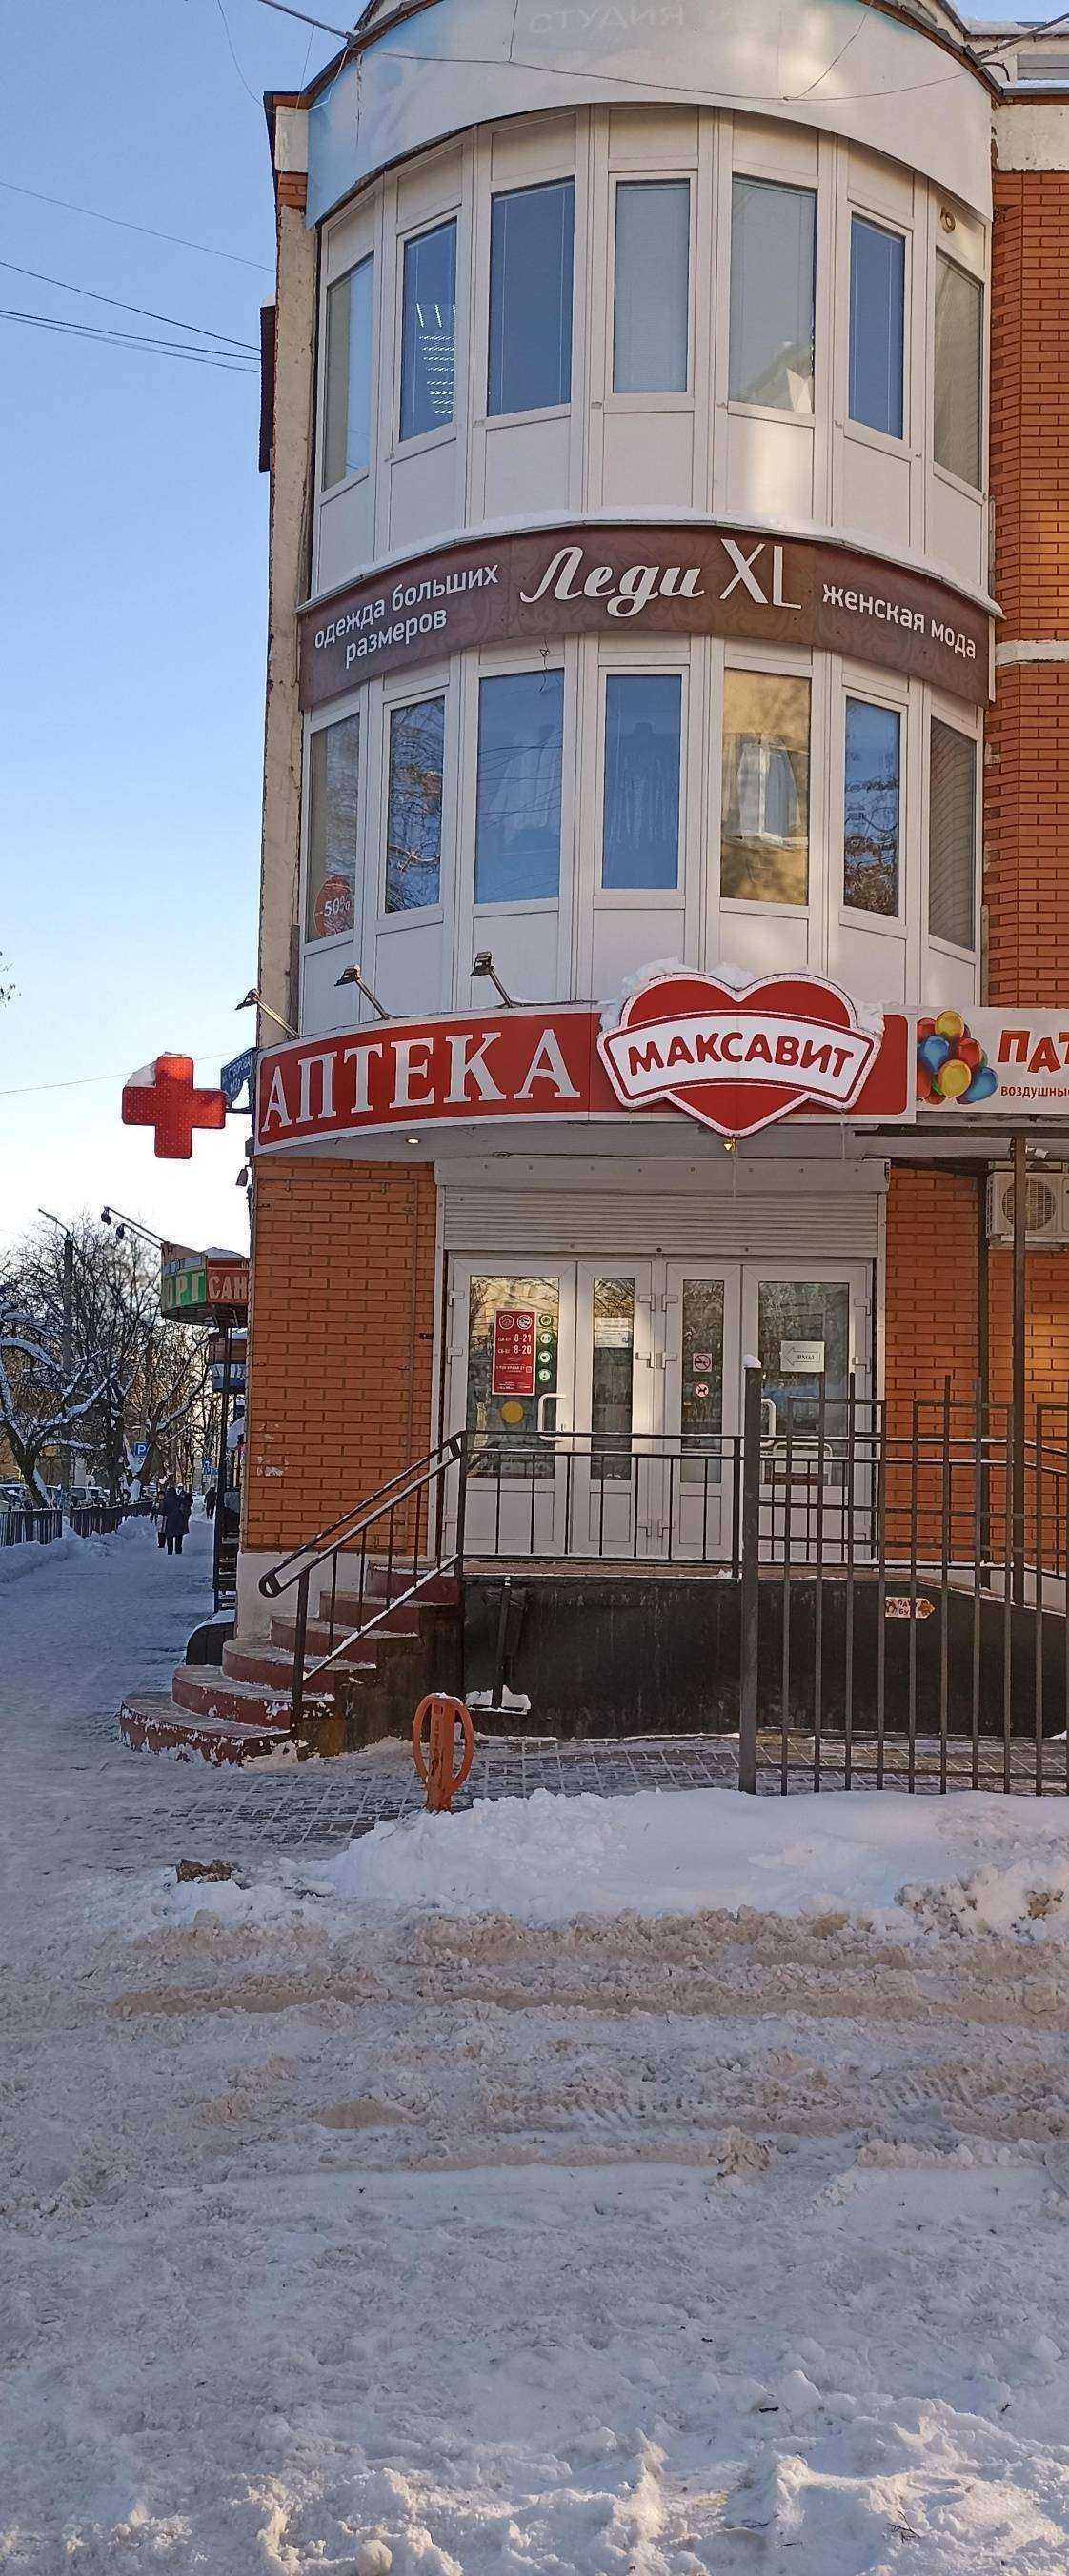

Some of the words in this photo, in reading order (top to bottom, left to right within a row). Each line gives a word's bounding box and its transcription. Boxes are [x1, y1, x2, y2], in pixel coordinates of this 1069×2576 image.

[530, 5, 686, 33] СТУДИЯ
[314, 599, 385, 650] одежда
[392, 564, 499, 612] больших
[519, 546, 705, 617] Леди
[719, 538, 802, 610] XL
[345, 608, 448, 669] размеров
[822, 583, 925, 634] женская
[931, 619, 977, 659] мода
[260, 1028, 580, 1132] АПТЕКА
[628, 1031, 855, 1077] МАКСАВИТ
[1001, 1086, 1069, 1099] воздушны
[514, 1345, 532, 1355] 8-20
